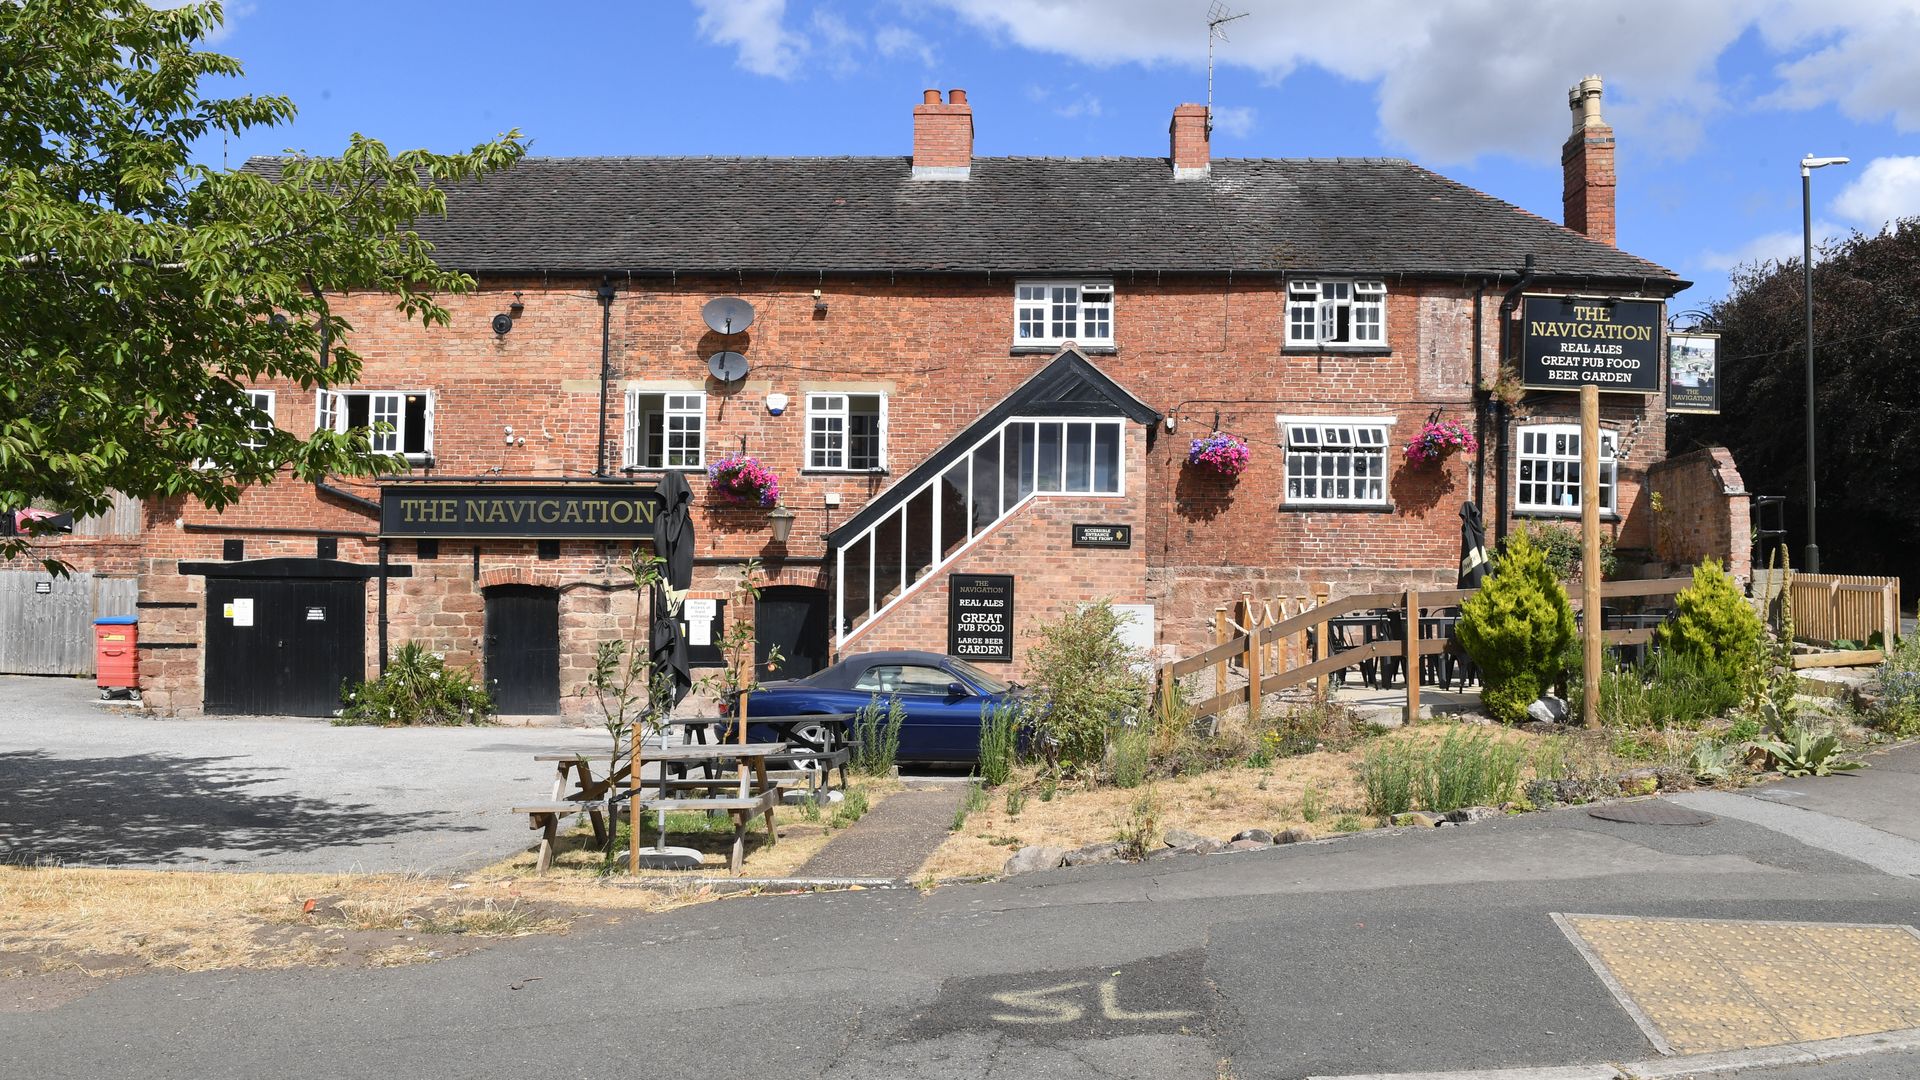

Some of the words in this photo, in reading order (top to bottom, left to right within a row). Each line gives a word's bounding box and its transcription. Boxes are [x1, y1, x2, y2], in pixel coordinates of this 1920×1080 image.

[1573, 306, 1610, 321] THE
[1531, 321, 1652, 341] NAVIGATION
[1560, 343, 1591, 353] REAL
[1593, 344, 1622, 354] ALES
[1541, 356, 1581, 366] GREAT
[1582, 357, 1604, 368] PUB
[1606, 358, 1641, 369] FOOD
[1548, 370, 1579, 380] BEER
[1581, 371, 1632, 382] GARDEN
[401, 500, 457, 522] THE
[465, 500, 657, 523] NAVIGATION
[959, 599, 981, 607] REAL
[961, 613, 1003, 623] GREAT
[957, 624, 975, 632] PUB
[977, 624, 1005, 632] FOOD
[957, 645, 1003, 654] GARDEN
